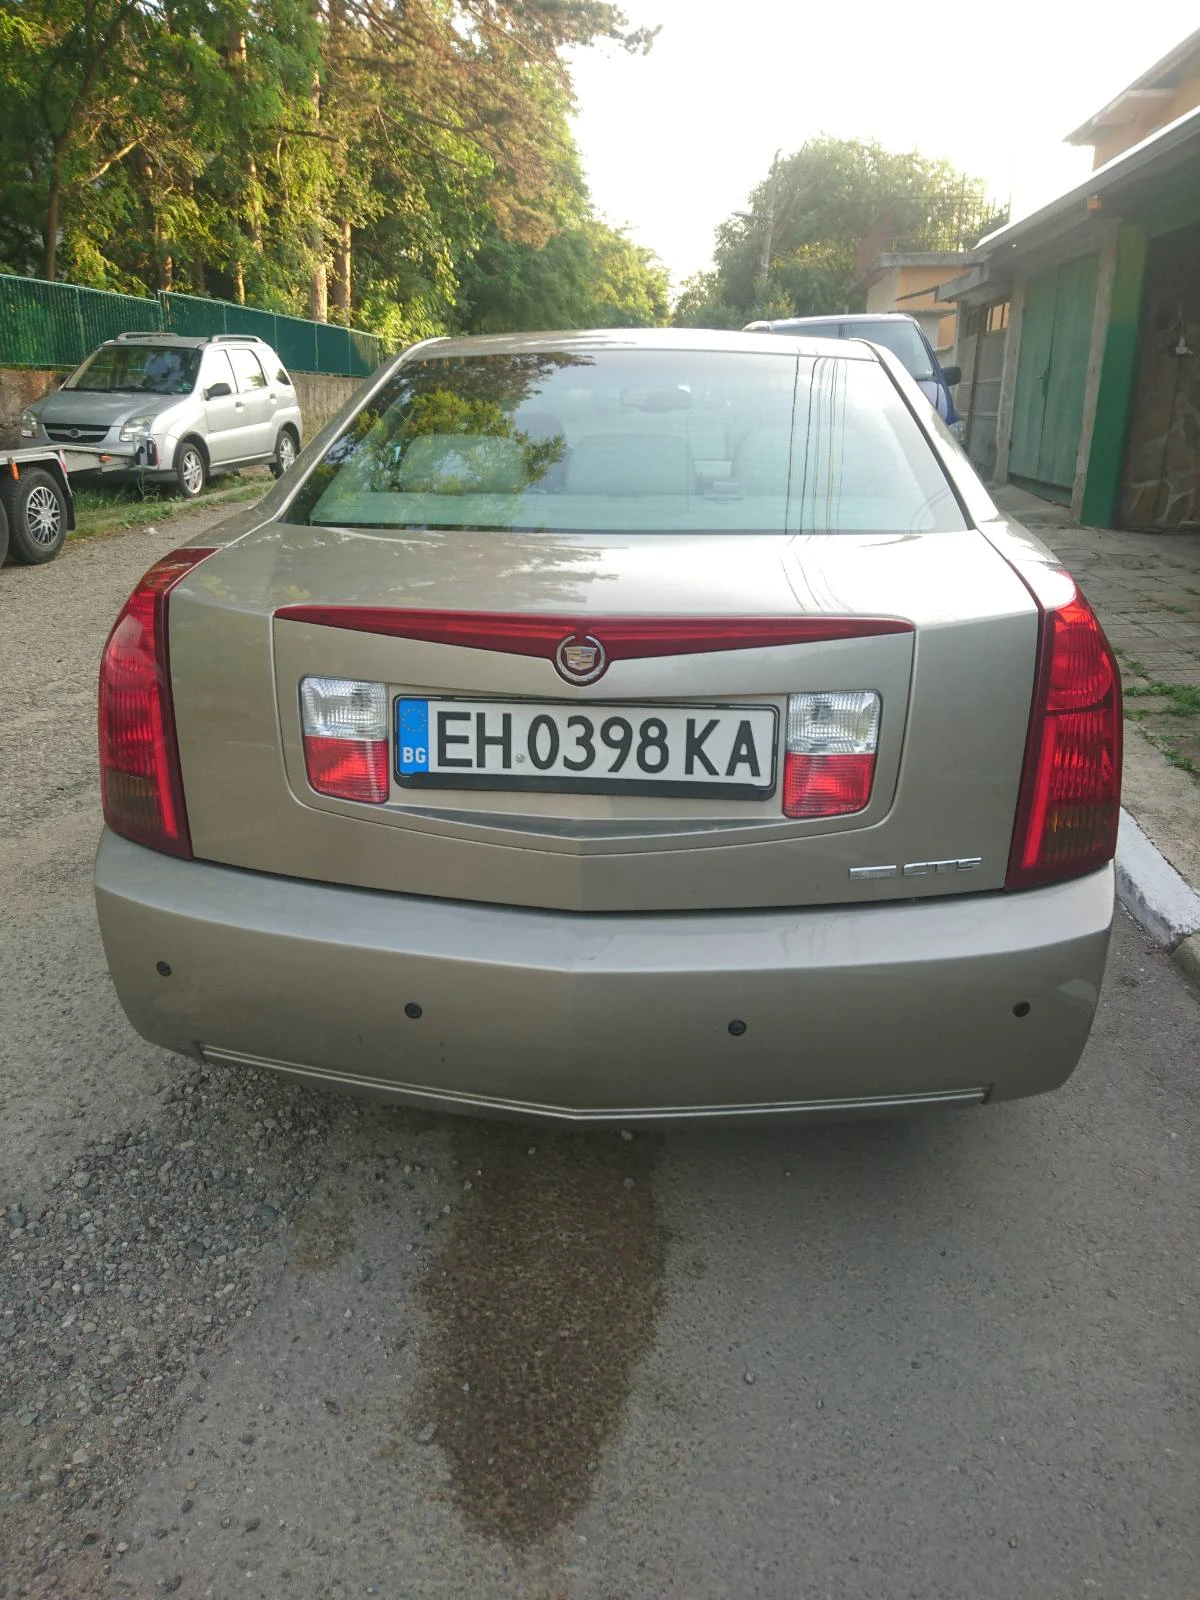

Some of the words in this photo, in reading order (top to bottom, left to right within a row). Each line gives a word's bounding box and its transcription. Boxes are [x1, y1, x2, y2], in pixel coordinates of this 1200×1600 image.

[436, 711, 513, 769] EH
[526, 713, 670, 774] 0398
[684, 718, 761, 777] KA
[402, 747, 426, 763] BG
[903, 857, 982, 876] CTS
